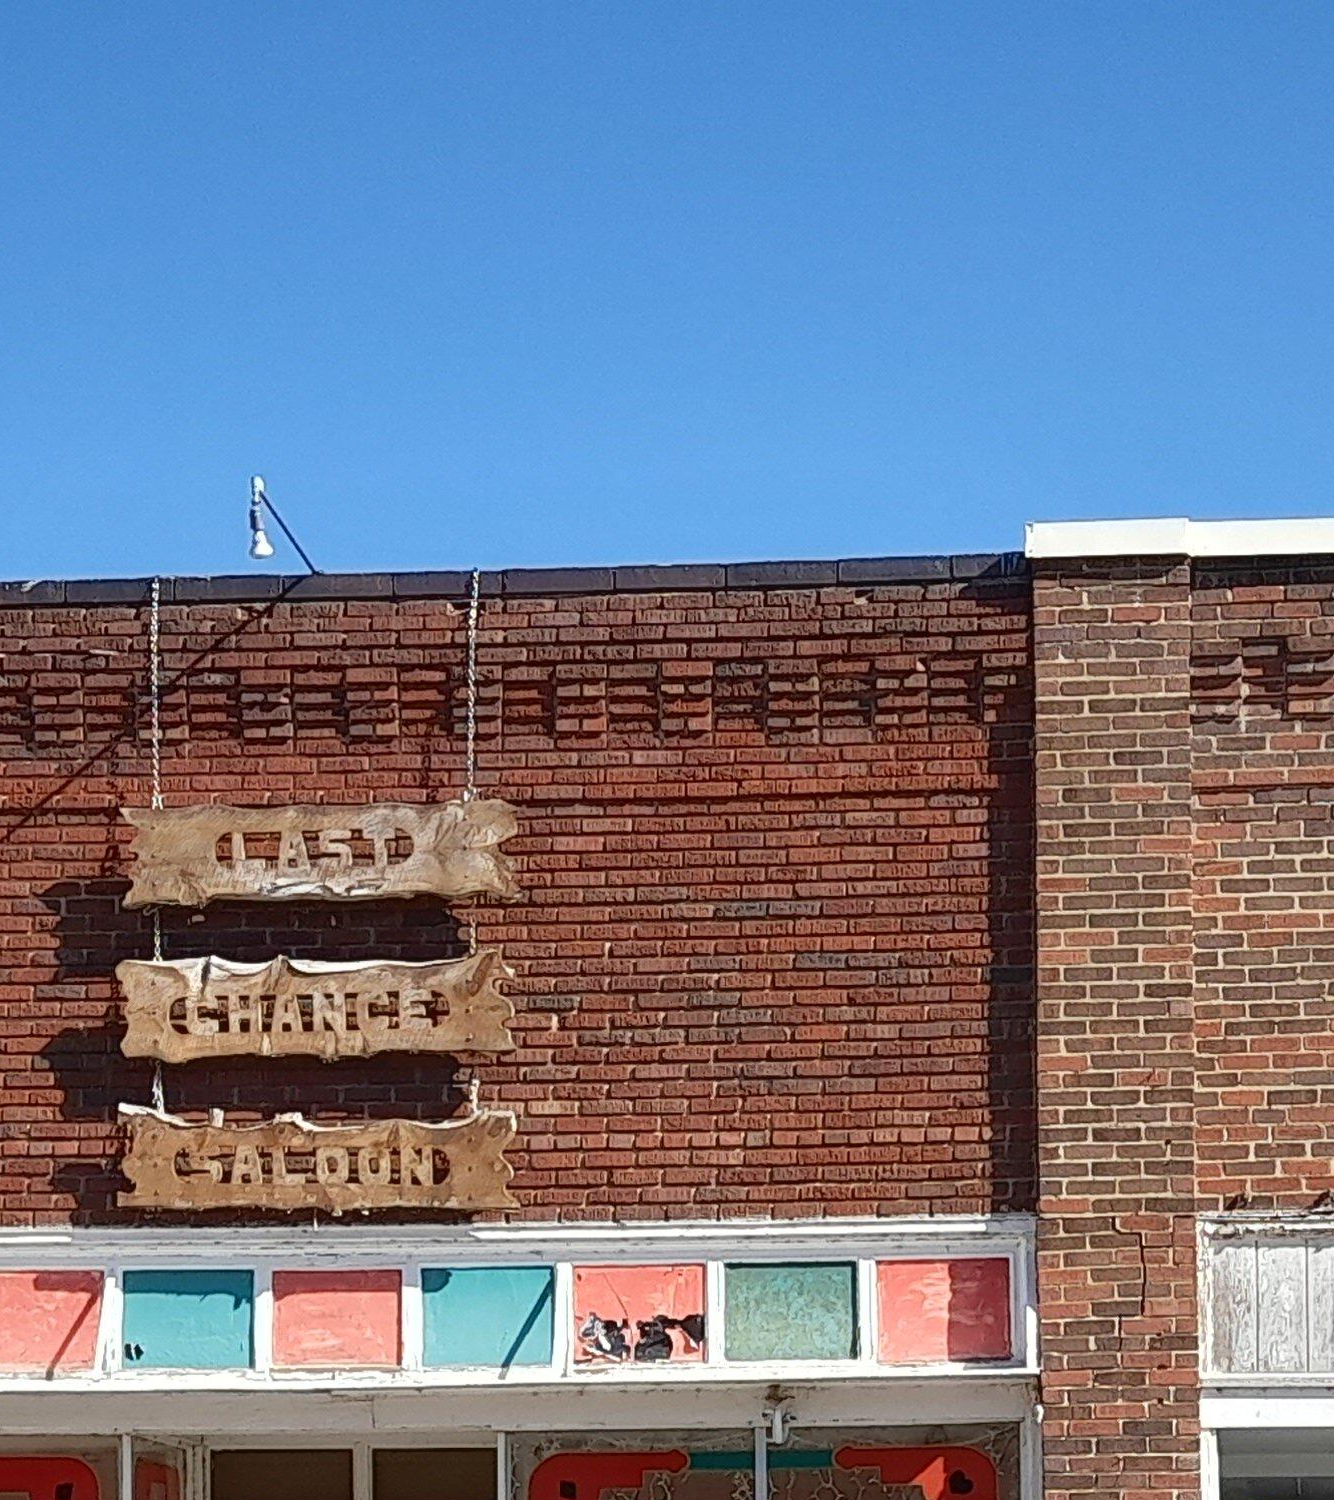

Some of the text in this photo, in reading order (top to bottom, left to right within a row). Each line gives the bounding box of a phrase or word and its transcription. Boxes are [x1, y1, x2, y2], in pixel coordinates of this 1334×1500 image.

[231, 829, 399, 872] LAST
[186, 989, 435, 1035] CHANCE
[179, 1146, 438, 1186] SALOON
